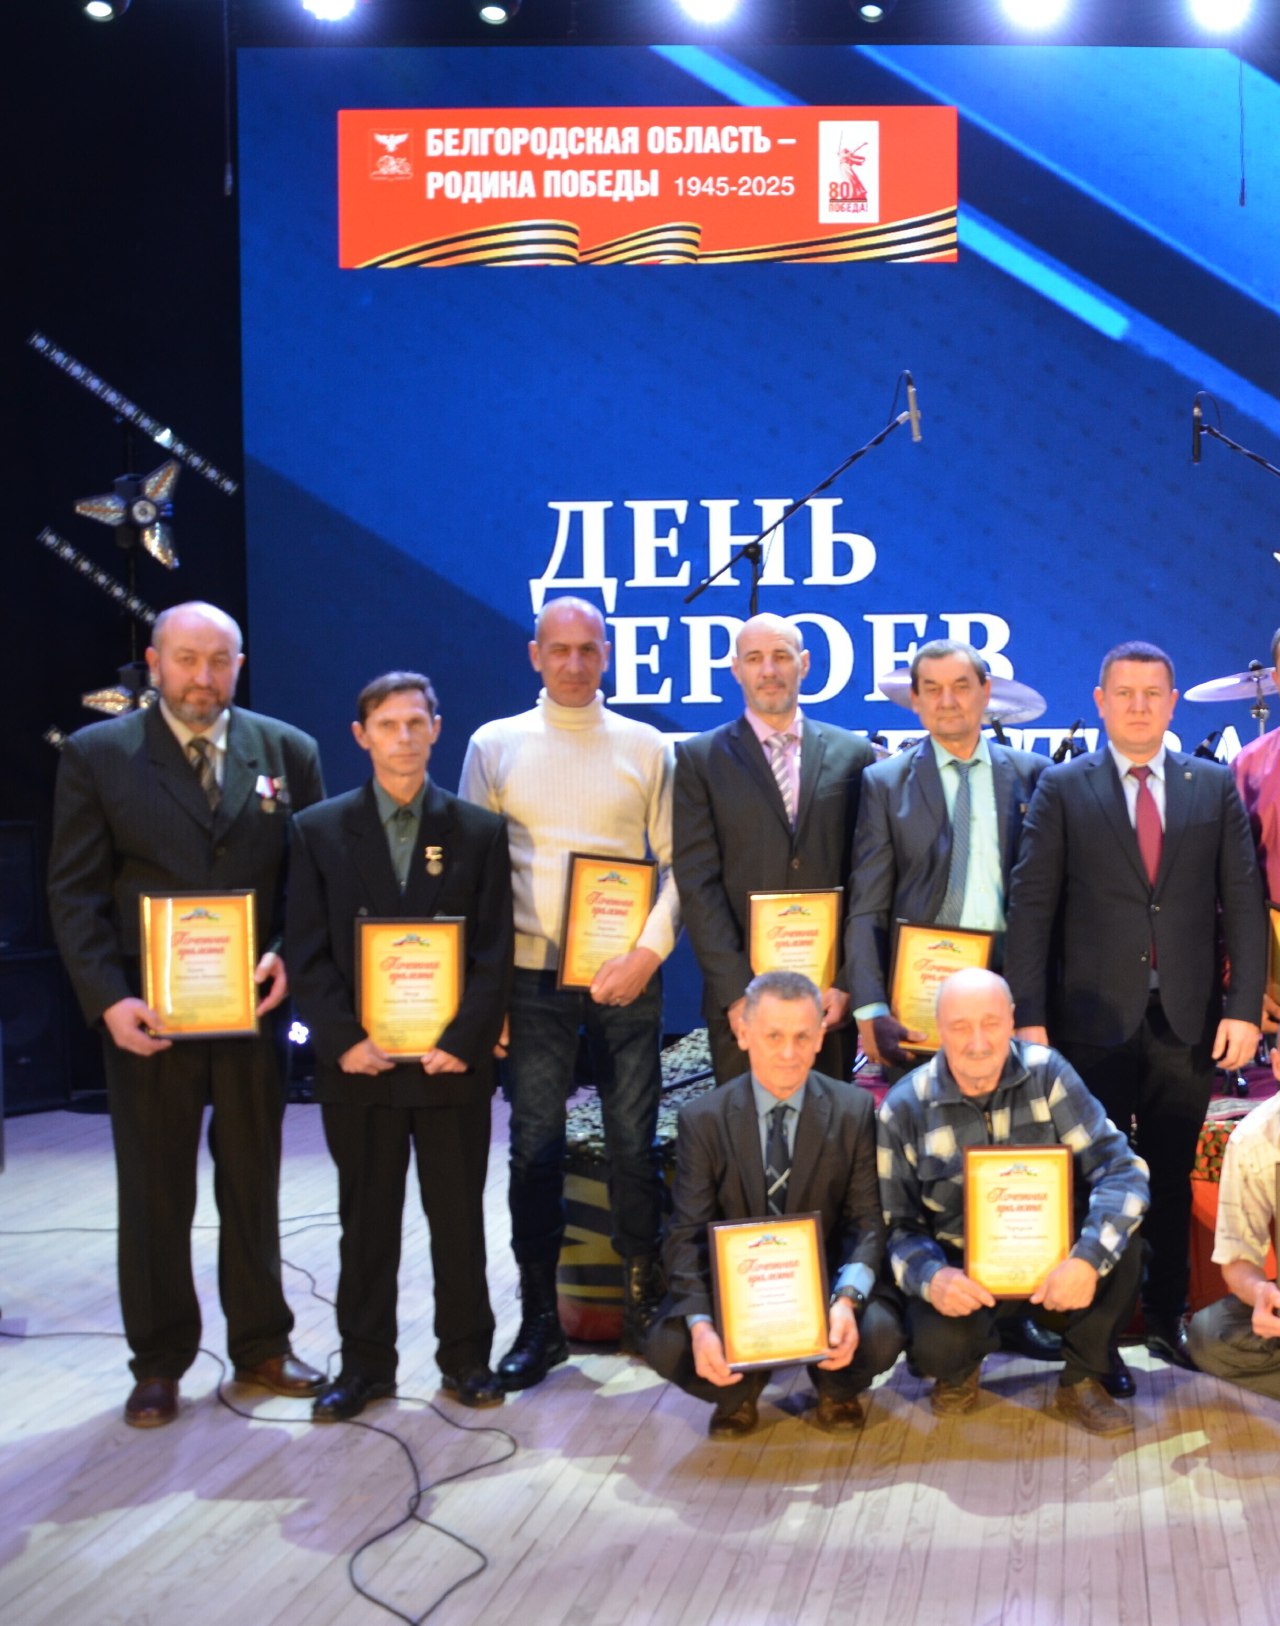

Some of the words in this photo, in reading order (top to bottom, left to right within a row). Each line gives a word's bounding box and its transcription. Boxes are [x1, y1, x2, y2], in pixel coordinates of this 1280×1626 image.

[426, 126, 640, 159] БЕЛГОРОДСКАЯ
[647, 125, 771, 156] ОБЛАСТЬ
[426, 171, 536, 203] РОДИНА
[543, 170, 659, 201] ПОБЕДЫ
[674, 176, 795, 198] 1945-2025
[828, 181, 850, 200] 80
[530, 498, 877, 613] ДЕНЬ
[606, 612, 1014, 704] ЕРОЕВ
